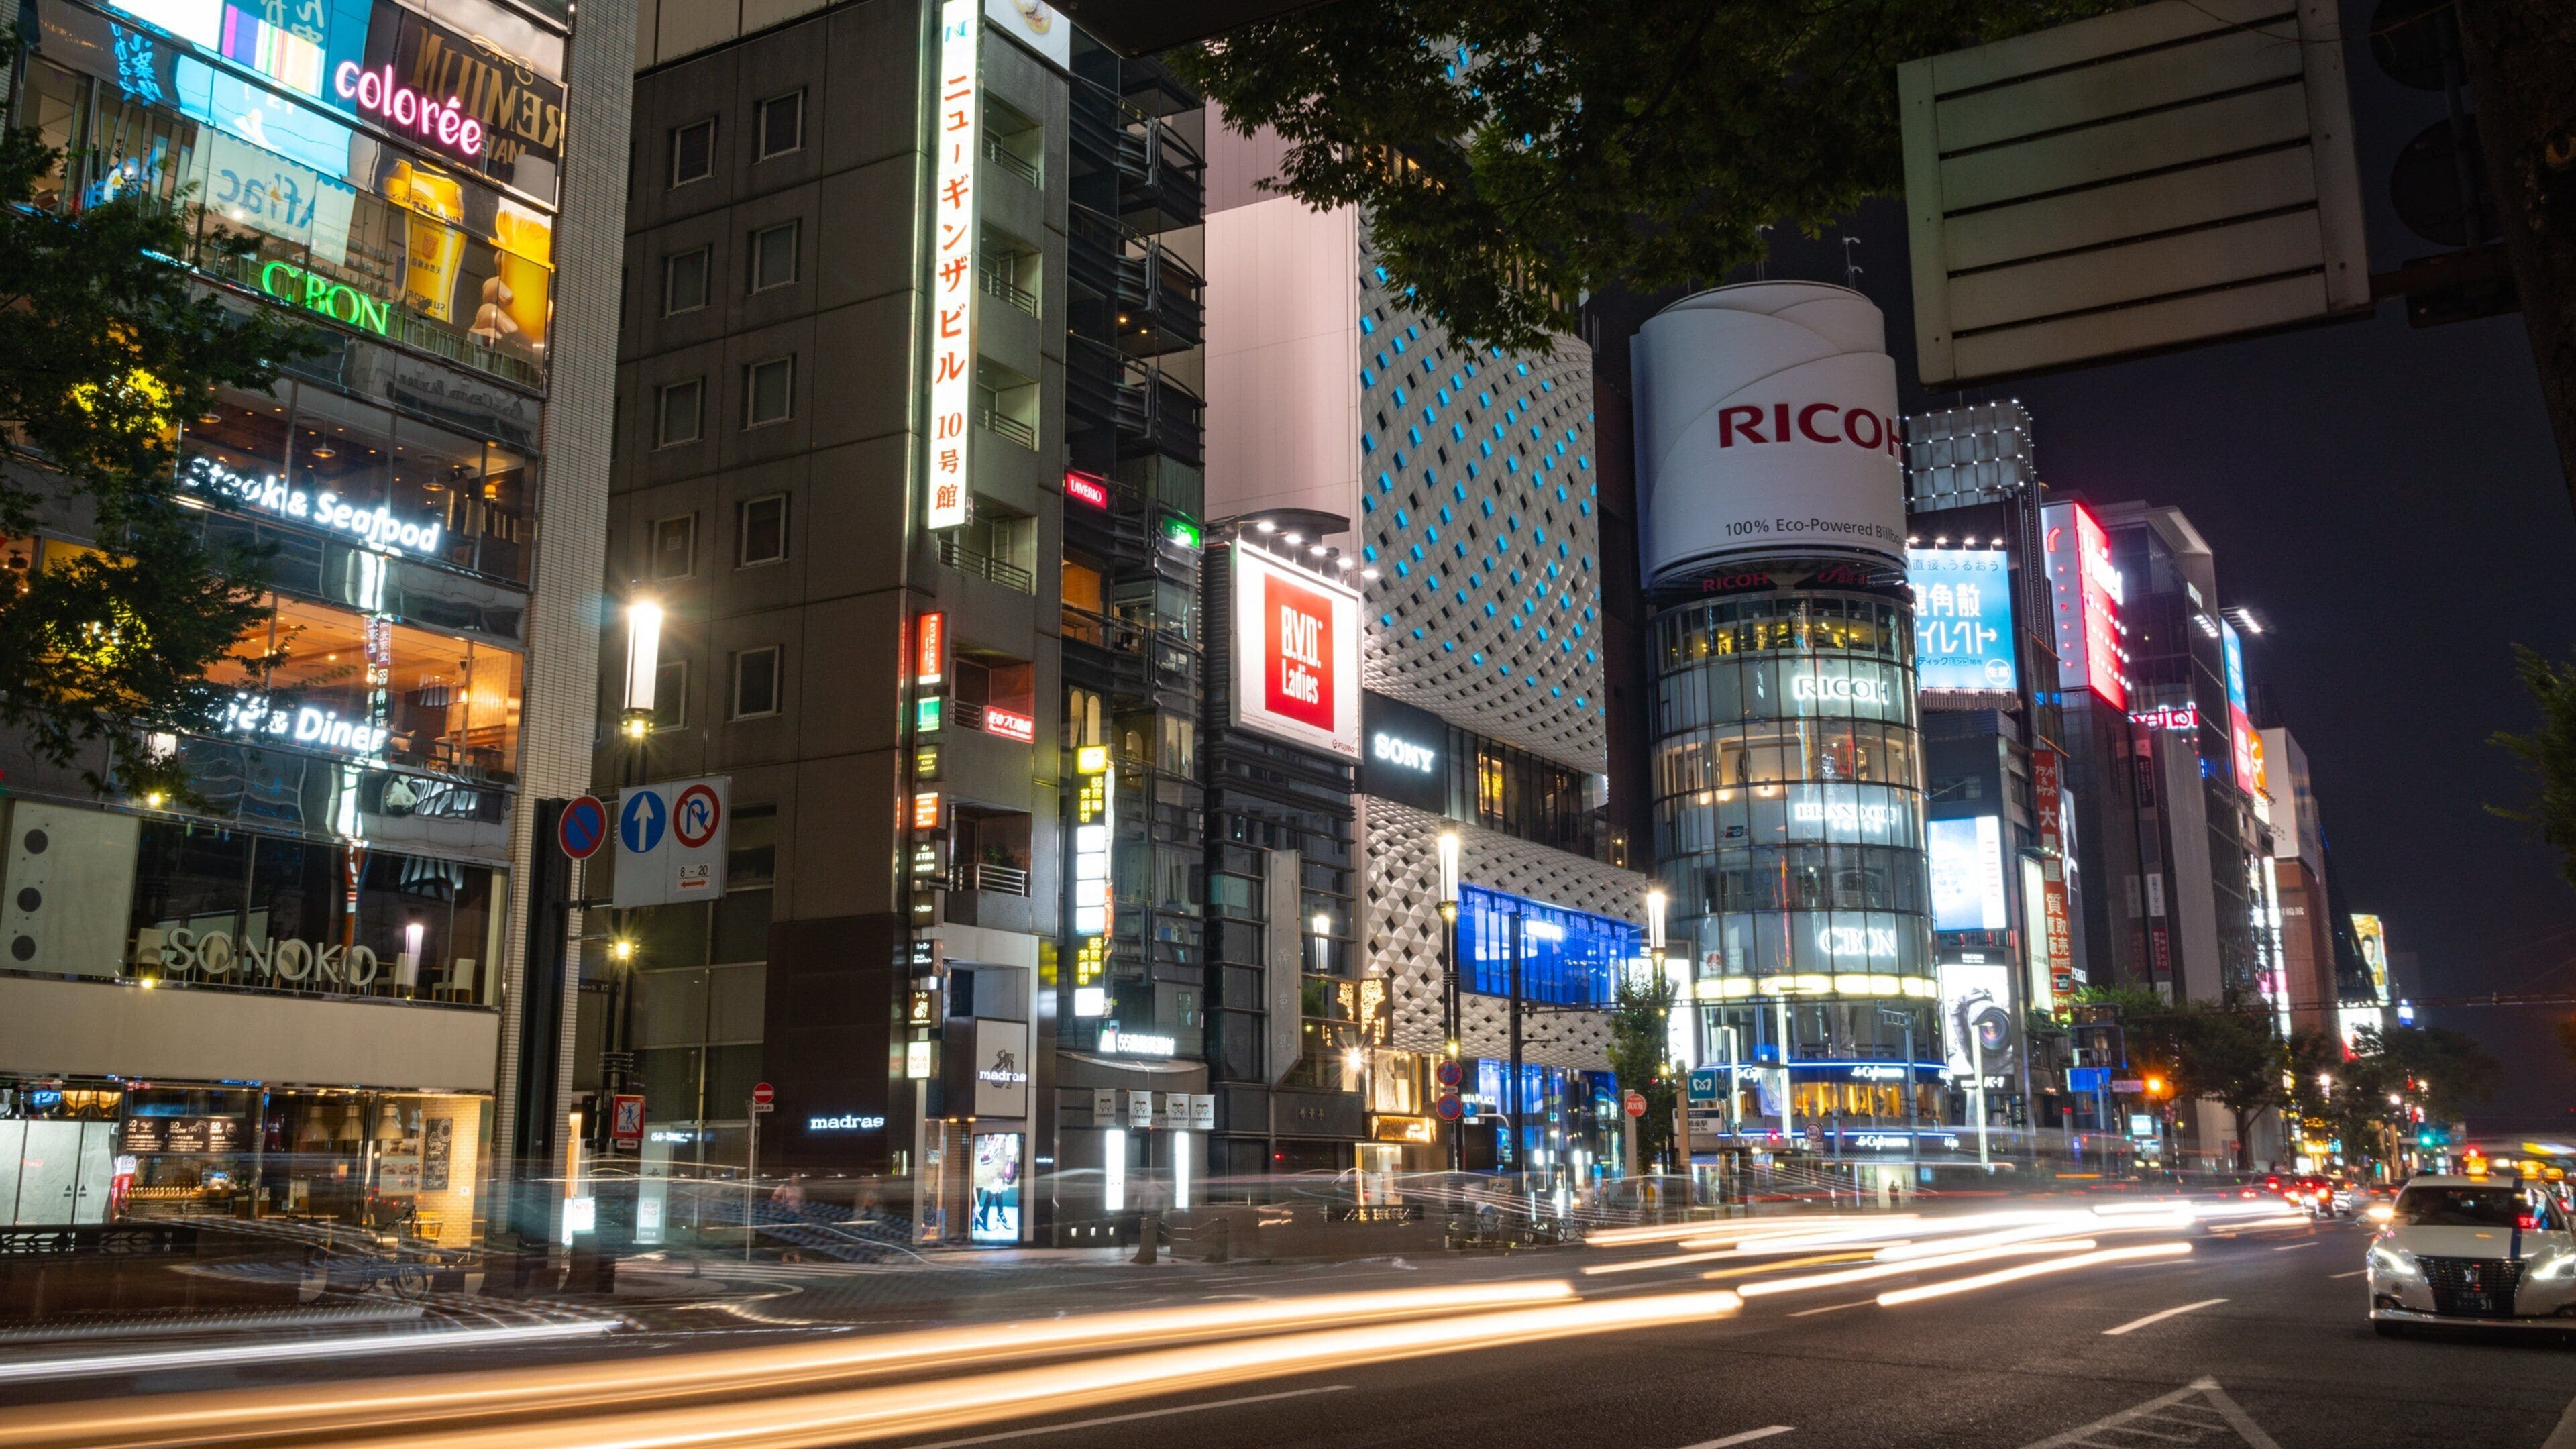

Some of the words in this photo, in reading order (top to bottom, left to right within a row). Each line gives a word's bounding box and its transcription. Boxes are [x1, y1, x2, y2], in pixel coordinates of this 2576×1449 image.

[335, 61, 481, 155] colorée
[936, 74, 972, 384] ニューギンザビル
[1719, 402, 1904, 464] RICOH
[936, 411, 963, 510] 10号館
[286, 490, 308, 519] &
[313, 492, 441, 553] Seafood
[1725, 519, 1770, 537] 100%
[1776, 518, 1872, 537] Eco-Powered
[1703, 573, 1769, 592] RICOH
[1916, 620, 1998, 655] イレクト
[1281, 657, 1319, 704] Ladies
[1795, 676, 1890, 704] RICOH
[295, 707, 388, 753] Diner
[1374, 733, 1434, 773] SONY
[680, 867, 686, 877] 8
[698, 865, 708, 876] 20
[979, 1070, 1028, 1083] madras
[810, 1114, 885, 1130] madras
